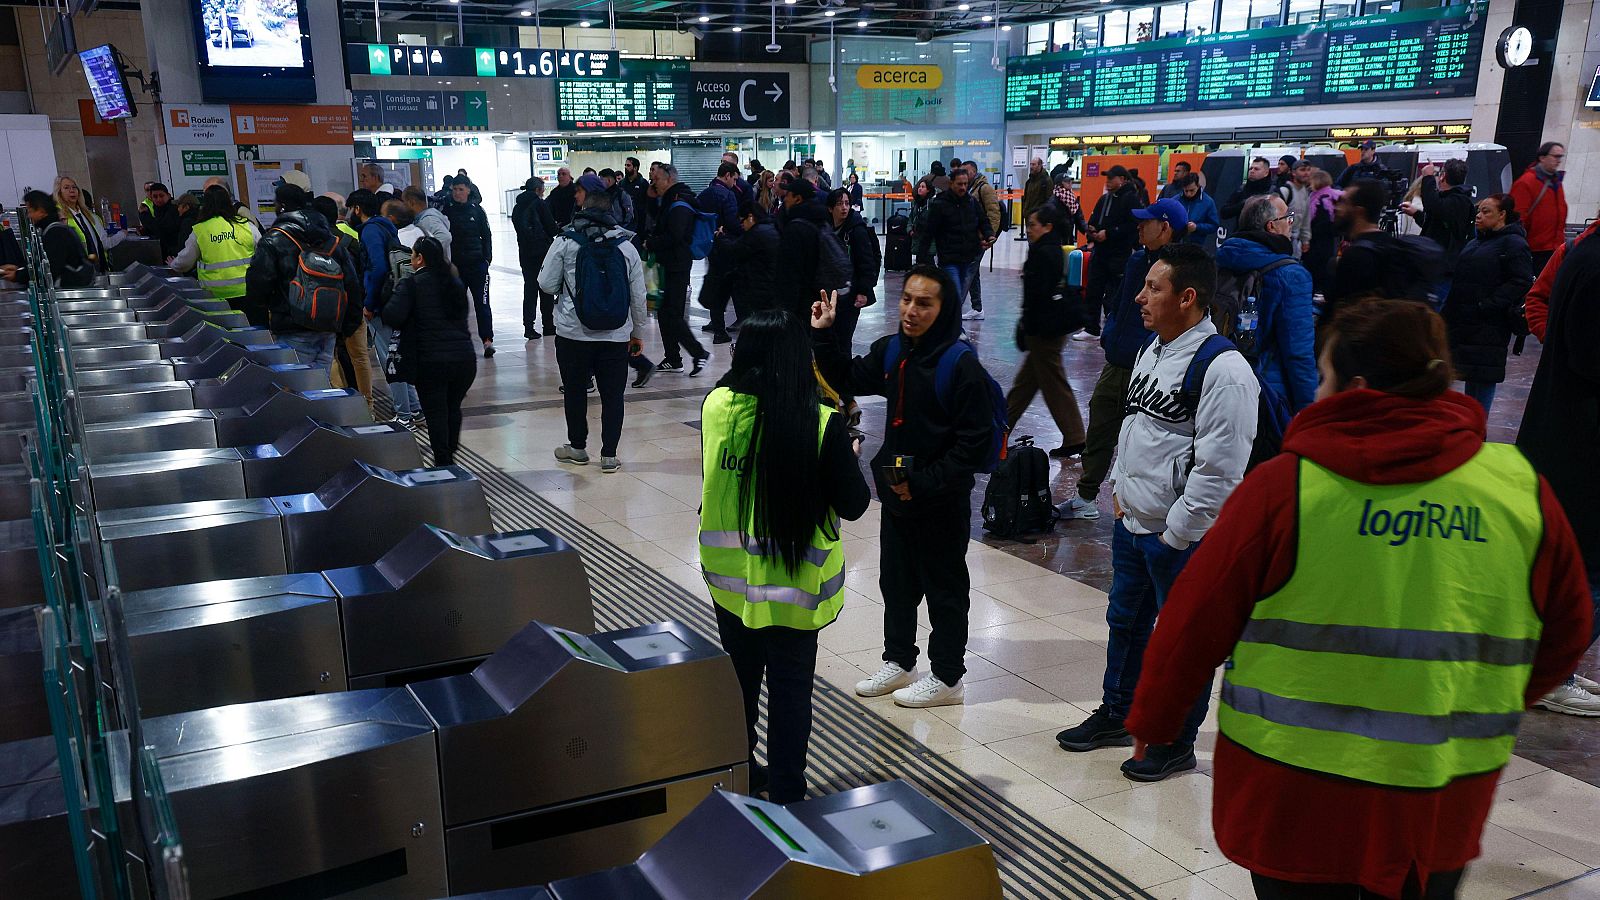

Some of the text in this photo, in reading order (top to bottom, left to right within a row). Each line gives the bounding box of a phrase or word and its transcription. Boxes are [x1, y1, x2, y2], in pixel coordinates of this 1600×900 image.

[394, 49, 402, 63] P
[513, 52, 553, 75] 1 a 6
[574, 52, 585, 75] C
[873, 70, 927, 83] acerca
[696, 81, 730, 92] Acceso
[385, 94, 420, 104] Consigna
[450, 96, 458, 110] P
[702, 97, 731, 109] Accés
[739, 79, 757, 122] C
[191, 116, 225, 124] Rodalies
[710, 113, 731, 121] ACCESS
[193, 131, 215, 139] renfe
[1359, 499, 1488, 546] logiRAIL
